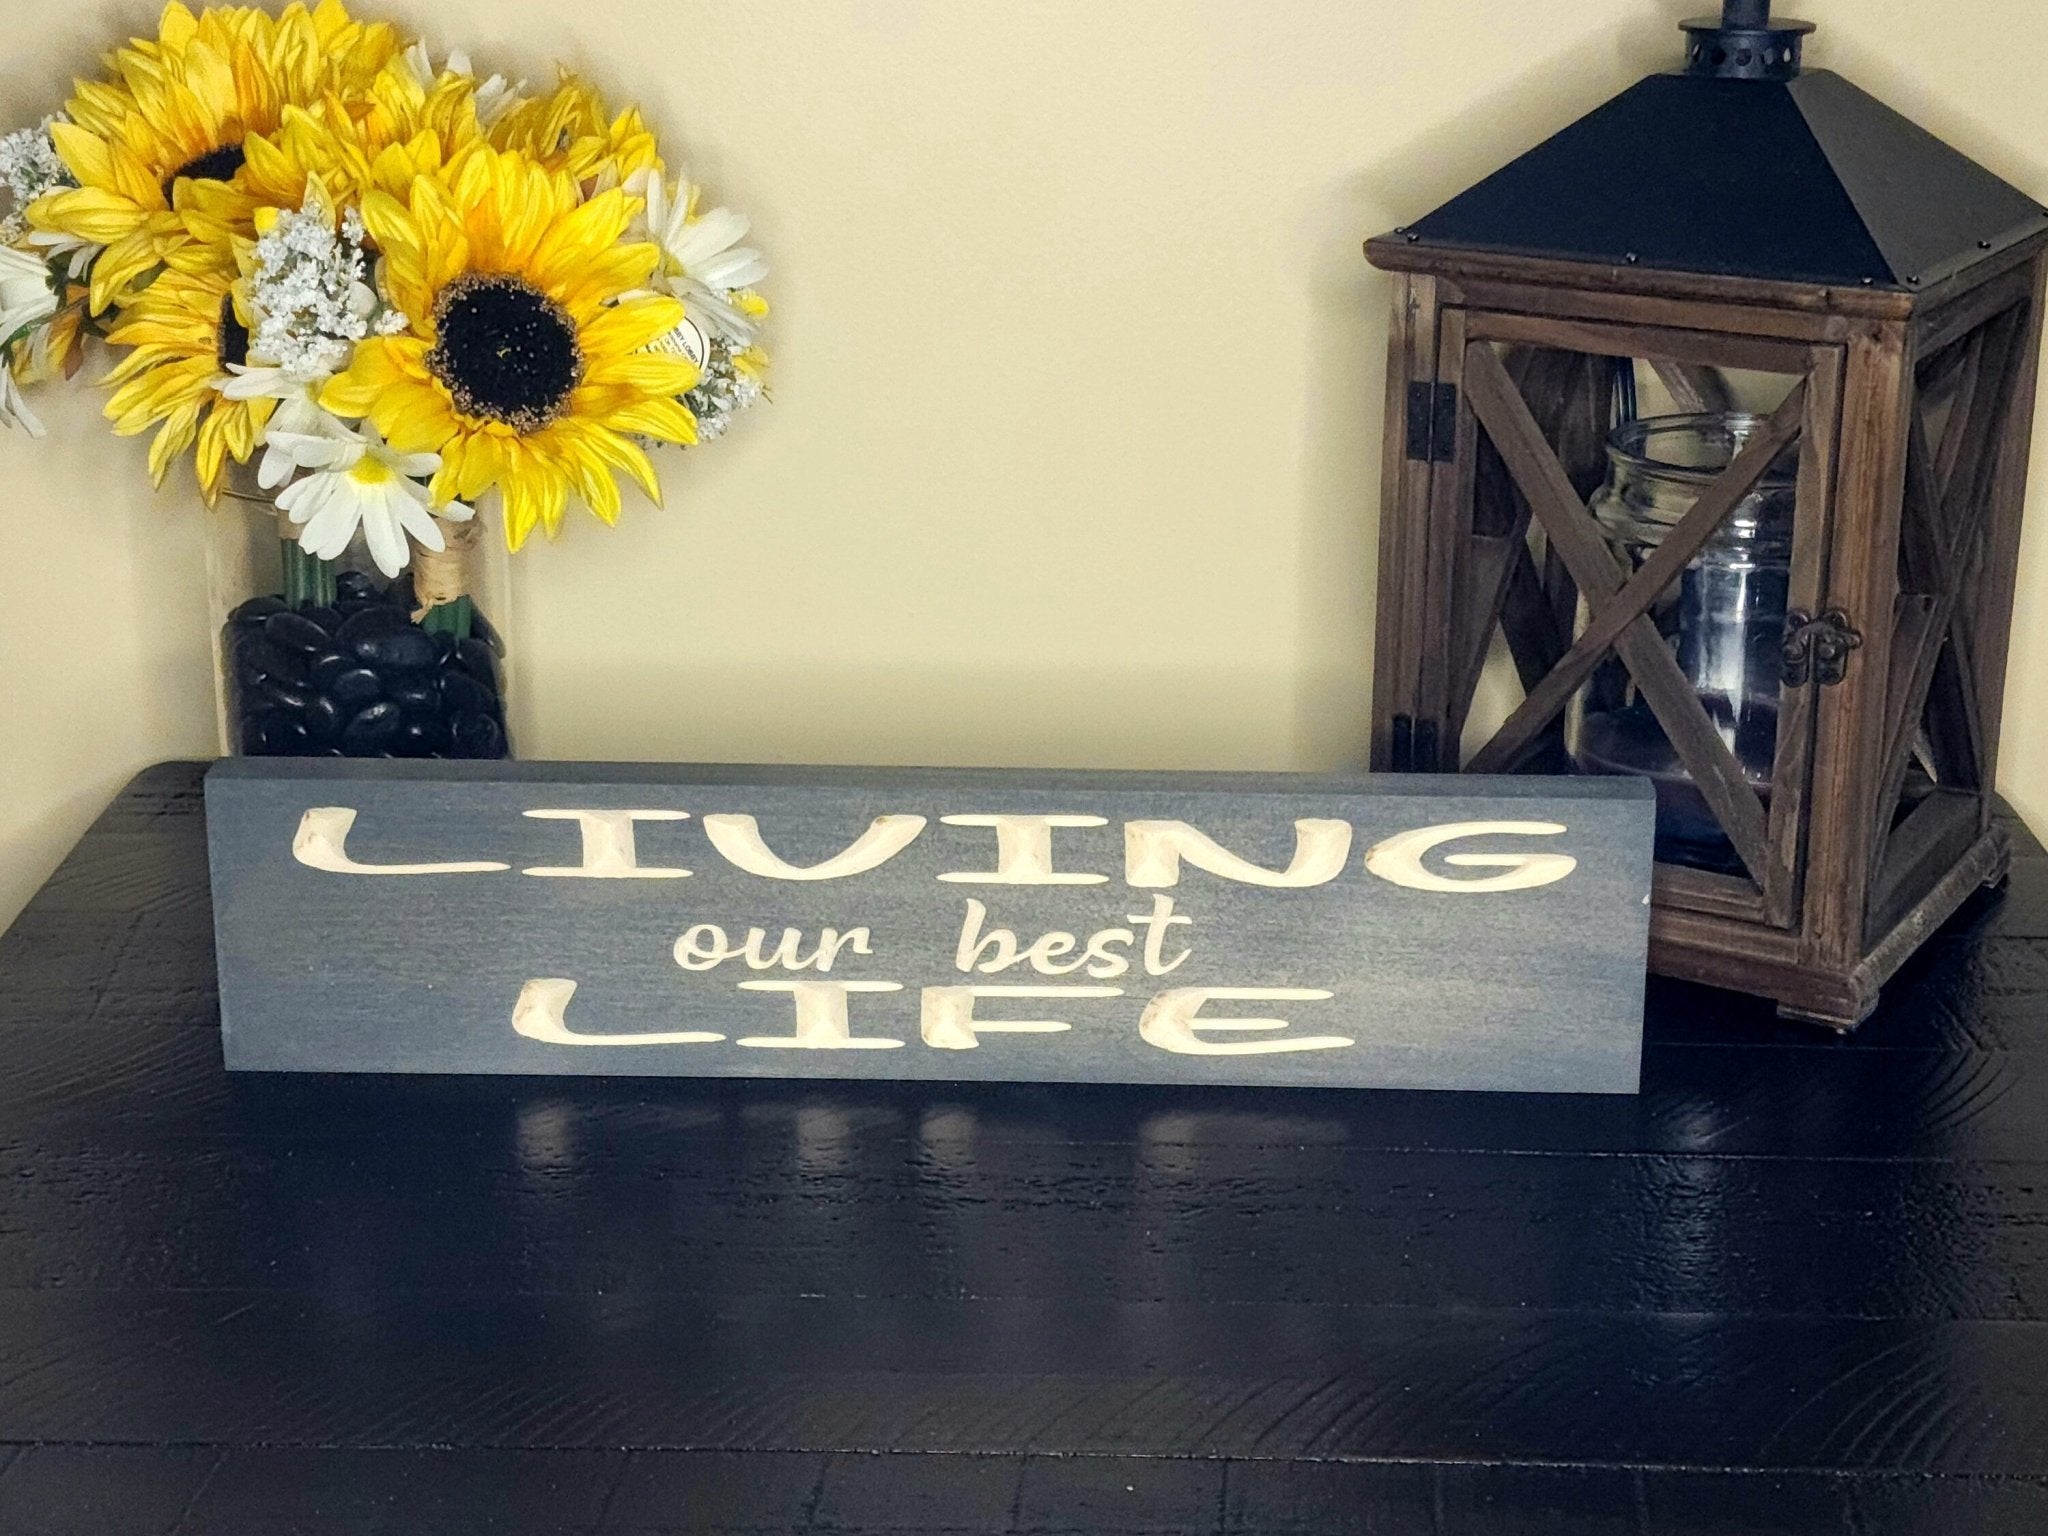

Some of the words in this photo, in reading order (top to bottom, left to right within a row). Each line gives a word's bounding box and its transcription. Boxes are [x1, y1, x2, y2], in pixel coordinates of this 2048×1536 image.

[682, 341, 699, 363] LOBBY
[292, 807, 1577, 893] LIVING
[673, 924, 873, 973] our
[956, 893, 1193, 979] best
[511, 977, 1356, 1056] LIFE
